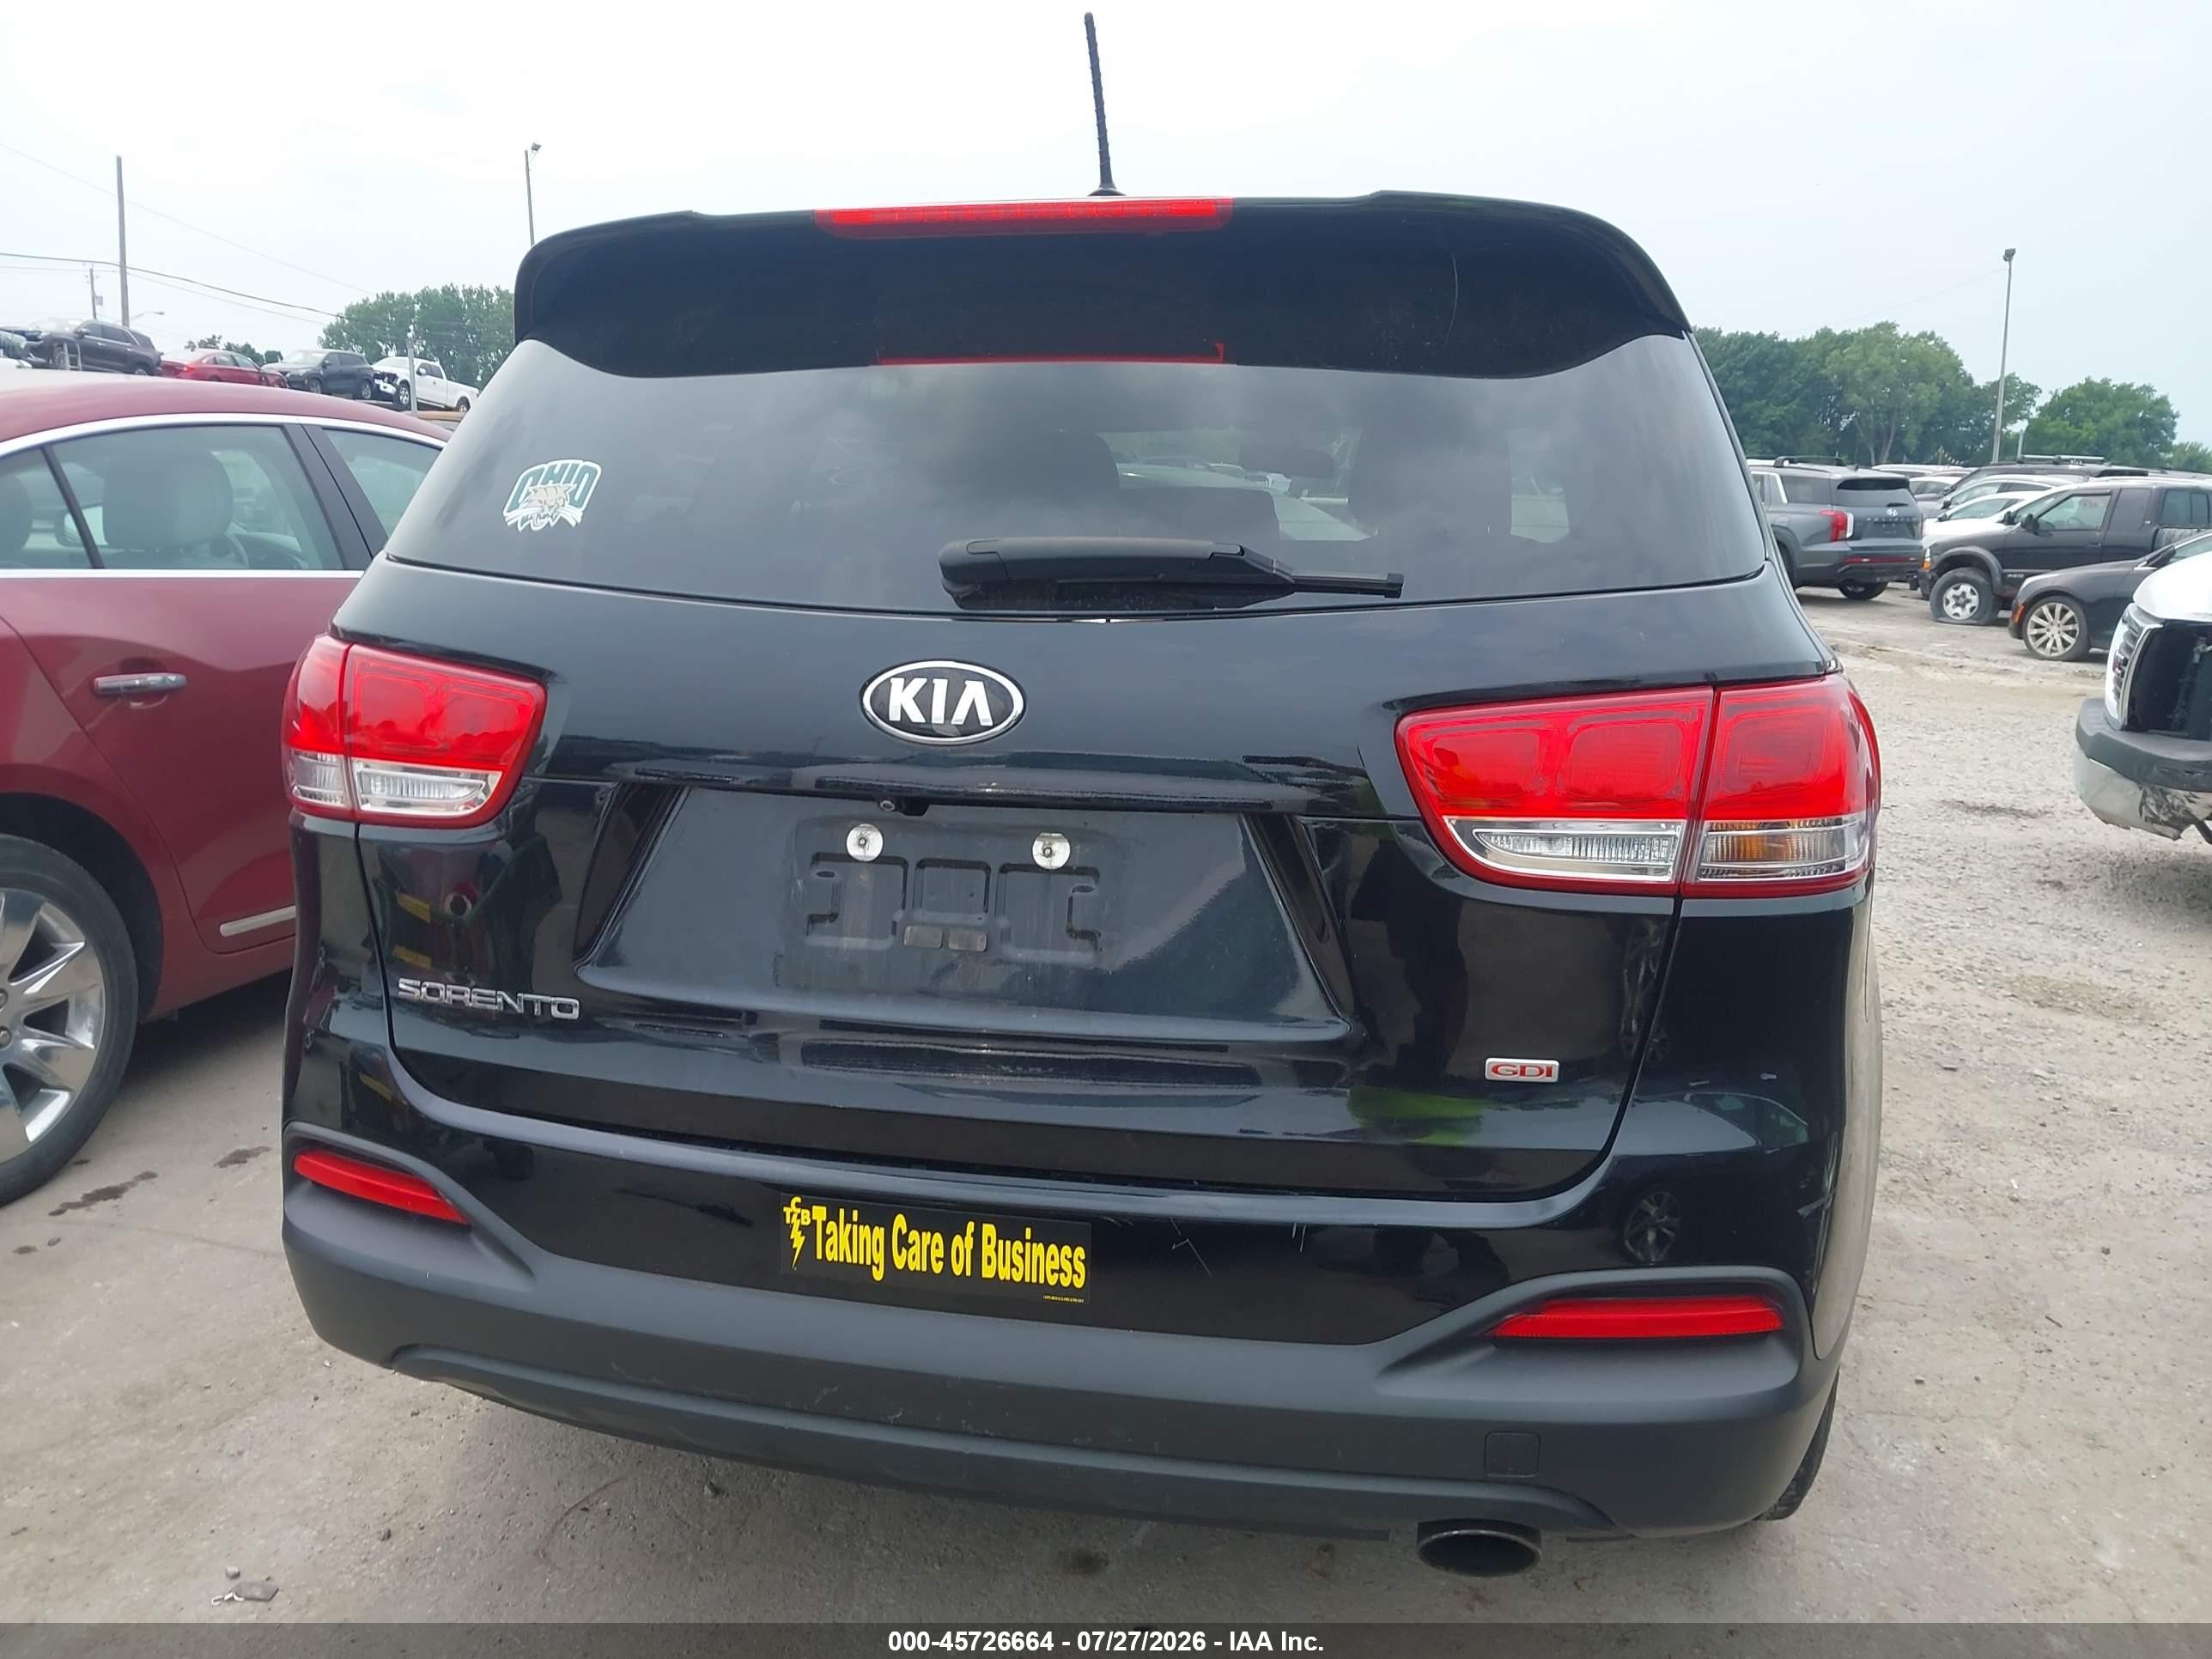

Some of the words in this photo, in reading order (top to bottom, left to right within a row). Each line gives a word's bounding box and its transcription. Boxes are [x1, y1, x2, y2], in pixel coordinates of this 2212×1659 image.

[503, 459, 602, 516] OHIO
[888, 677, 994, 726] KIA
[398, 977, 580, 1020] SORENTO
[1491, 1063, 1553, 1078] GDI
[811, 1205, 885, 1281] Taking
[891, 1212, 945, 1274] Care
[951, 1220, 975, 1277] of
[981, 1223, 1086, 1289] Business
